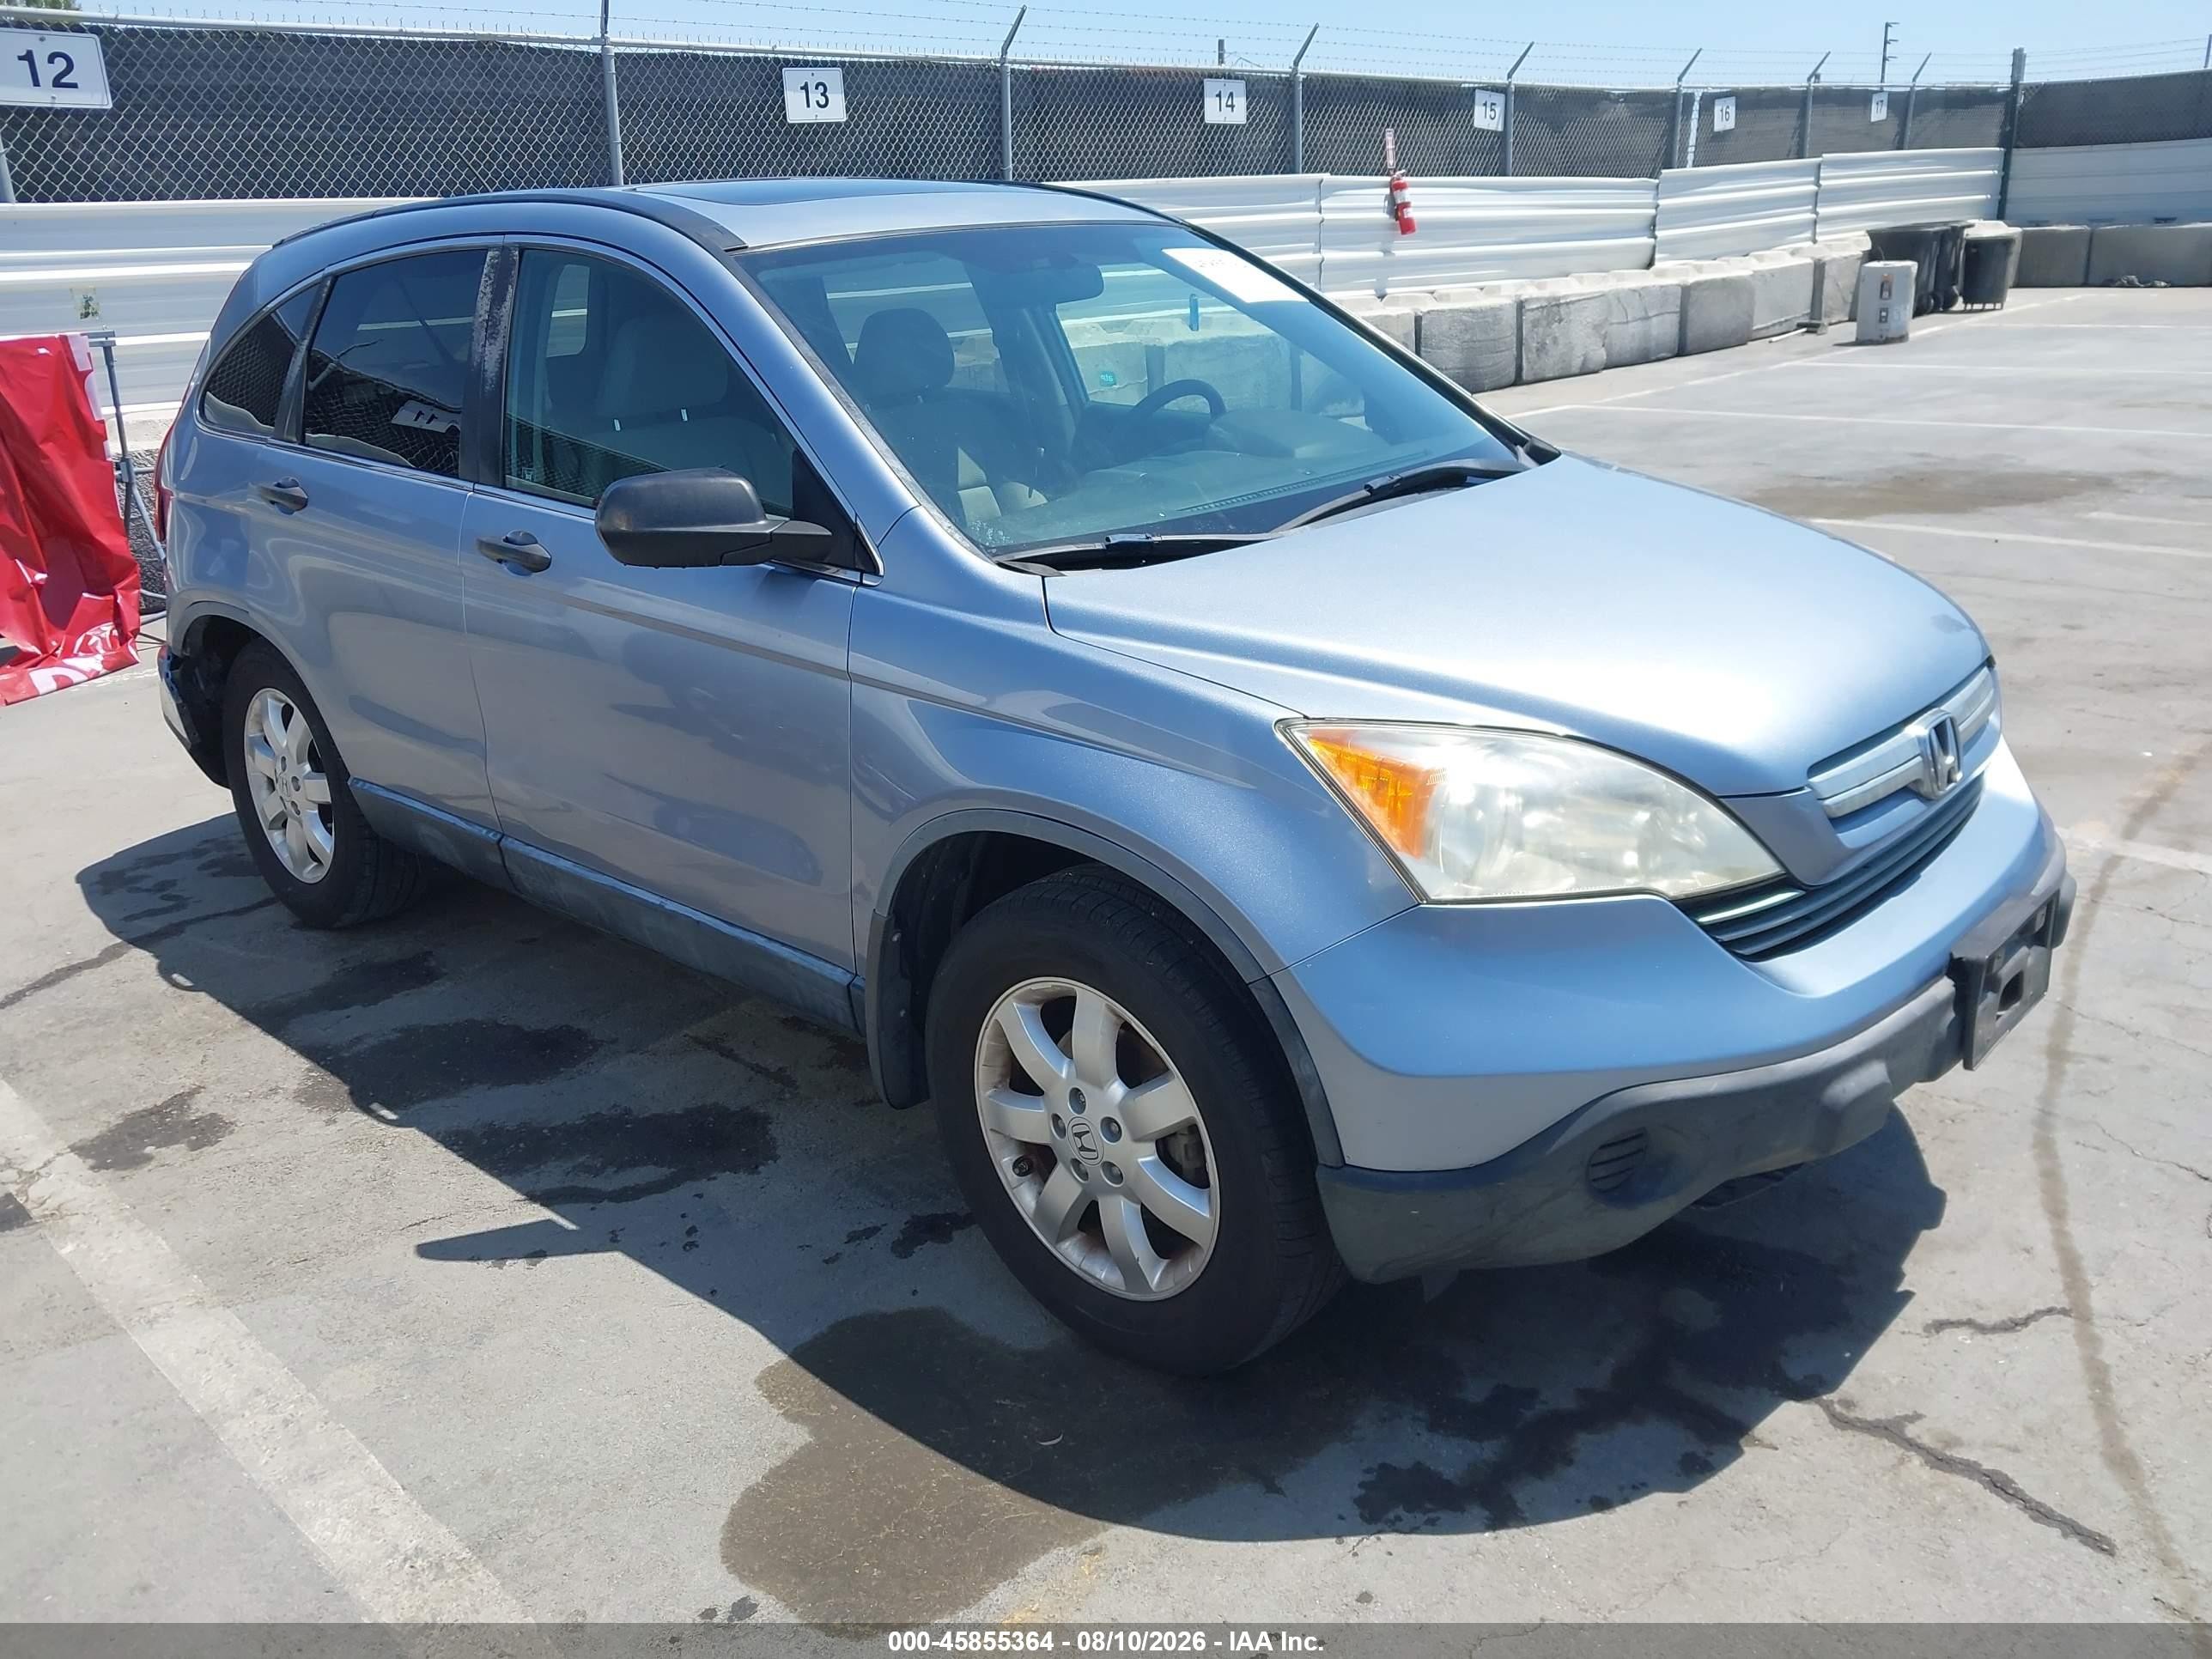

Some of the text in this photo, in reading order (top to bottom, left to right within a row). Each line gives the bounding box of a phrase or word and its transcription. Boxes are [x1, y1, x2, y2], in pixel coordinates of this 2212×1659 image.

[17, 49, 79, 89] 12
[799, 81, 830, 109] 13
[1215, 89, 1236, 112] 14
[1483, 100, 1497, 120] 15
[1720, 105, 1730, 122] 16
[1875, 100, 1884, 113] 17
